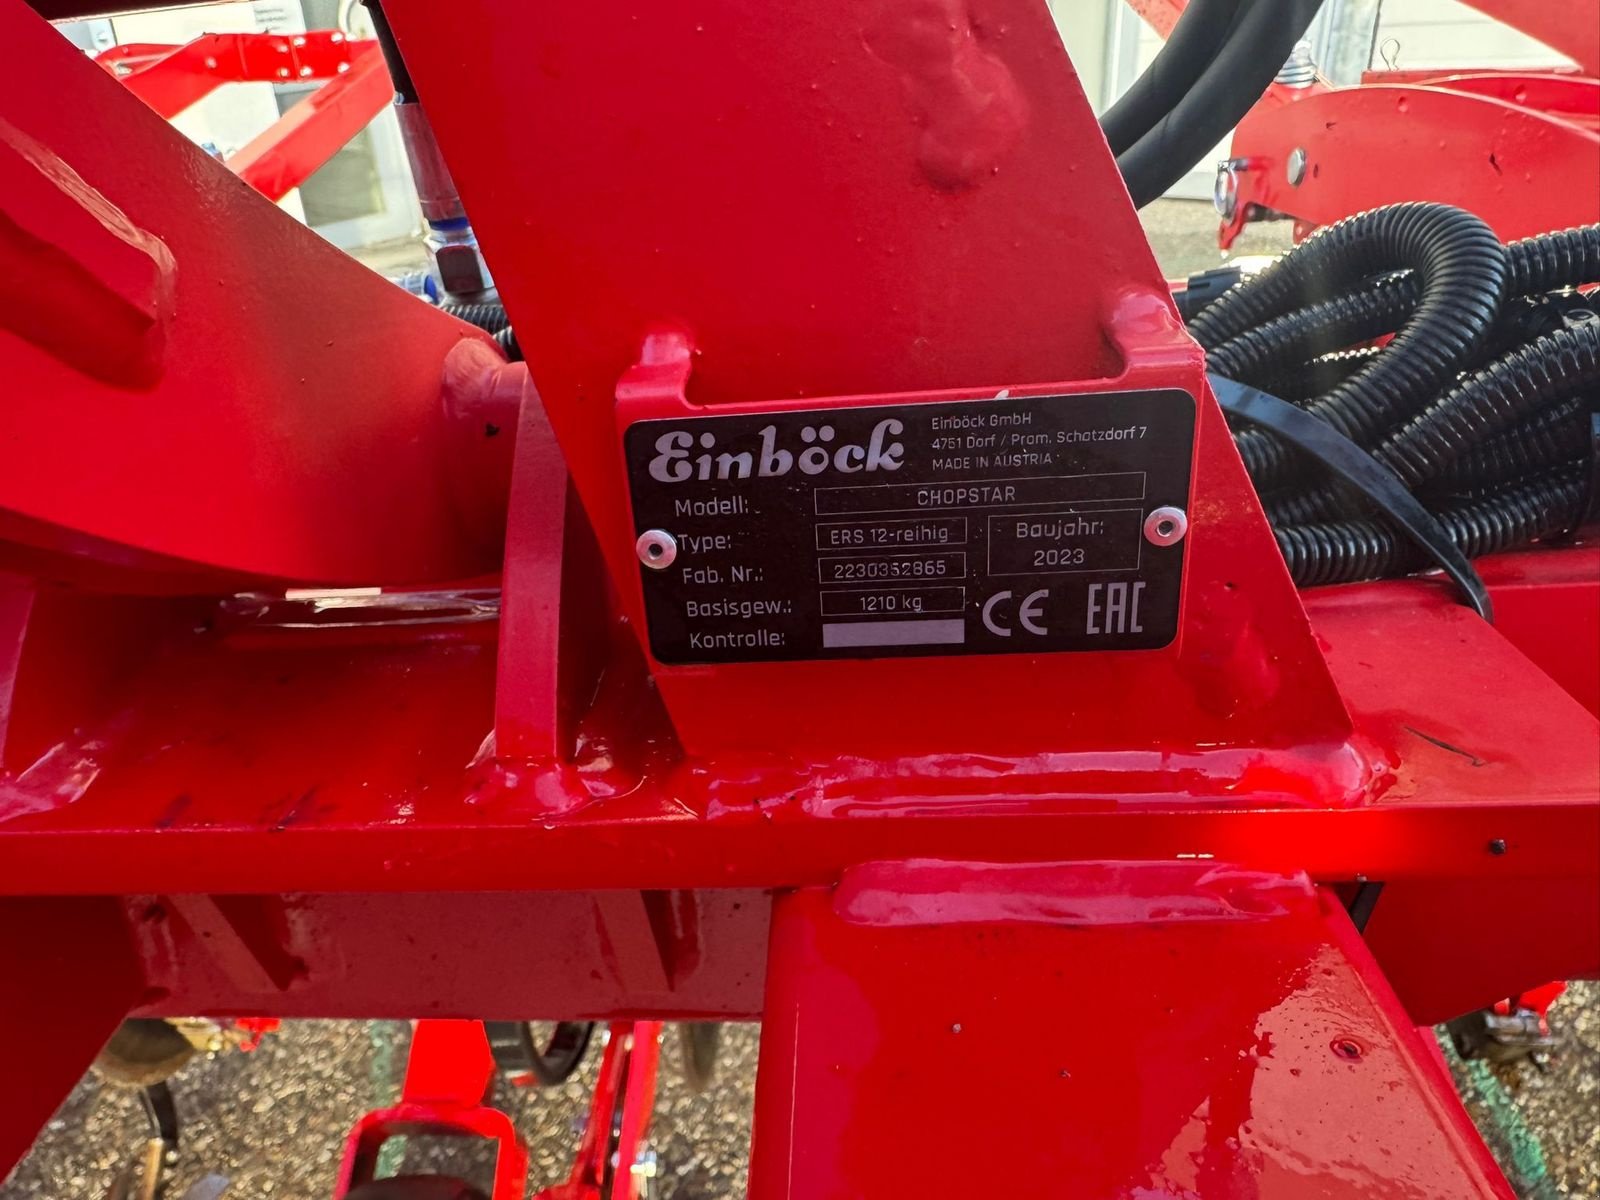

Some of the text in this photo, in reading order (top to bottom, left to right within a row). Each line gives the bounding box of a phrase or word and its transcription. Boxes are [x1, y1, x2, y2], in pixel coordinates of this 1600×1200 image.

[932, 412, 1032, 430] Einböck GmbH
[932, 437, 962, 450] 4751
[966, 434, 996, 449] Dorf
[1000, 433, 1006, 447] /
[1011, 433, 1052, 446] Pram.
[1139, 426, 1147, 439] 7
[648, 418, 905, 483] Einböck
[932, 452, 1052, 471] MADE IN AUSTRIA
[675, 495, 749, 517] Modell:
[917, 486, 1016, 506] CHOPSTAR
[830, 524, 949, 545] ERS 12-reihig
[1016, 517, 1104, 540] Baujahr:
[677, 534, 731, 554] Type:
[1034, 548, 1085, 566] 2023
[683, 565, 763, 584] Fab. Nr.:
[834, 560, 946, 579] 2230352865
[686, 598, 792, 618] Basisgew.:
[860, 594, 922, 612] 1210 kg
[982, 589, 1049, 637] CE
[690, 629, 785, 649] Kontrolle:
